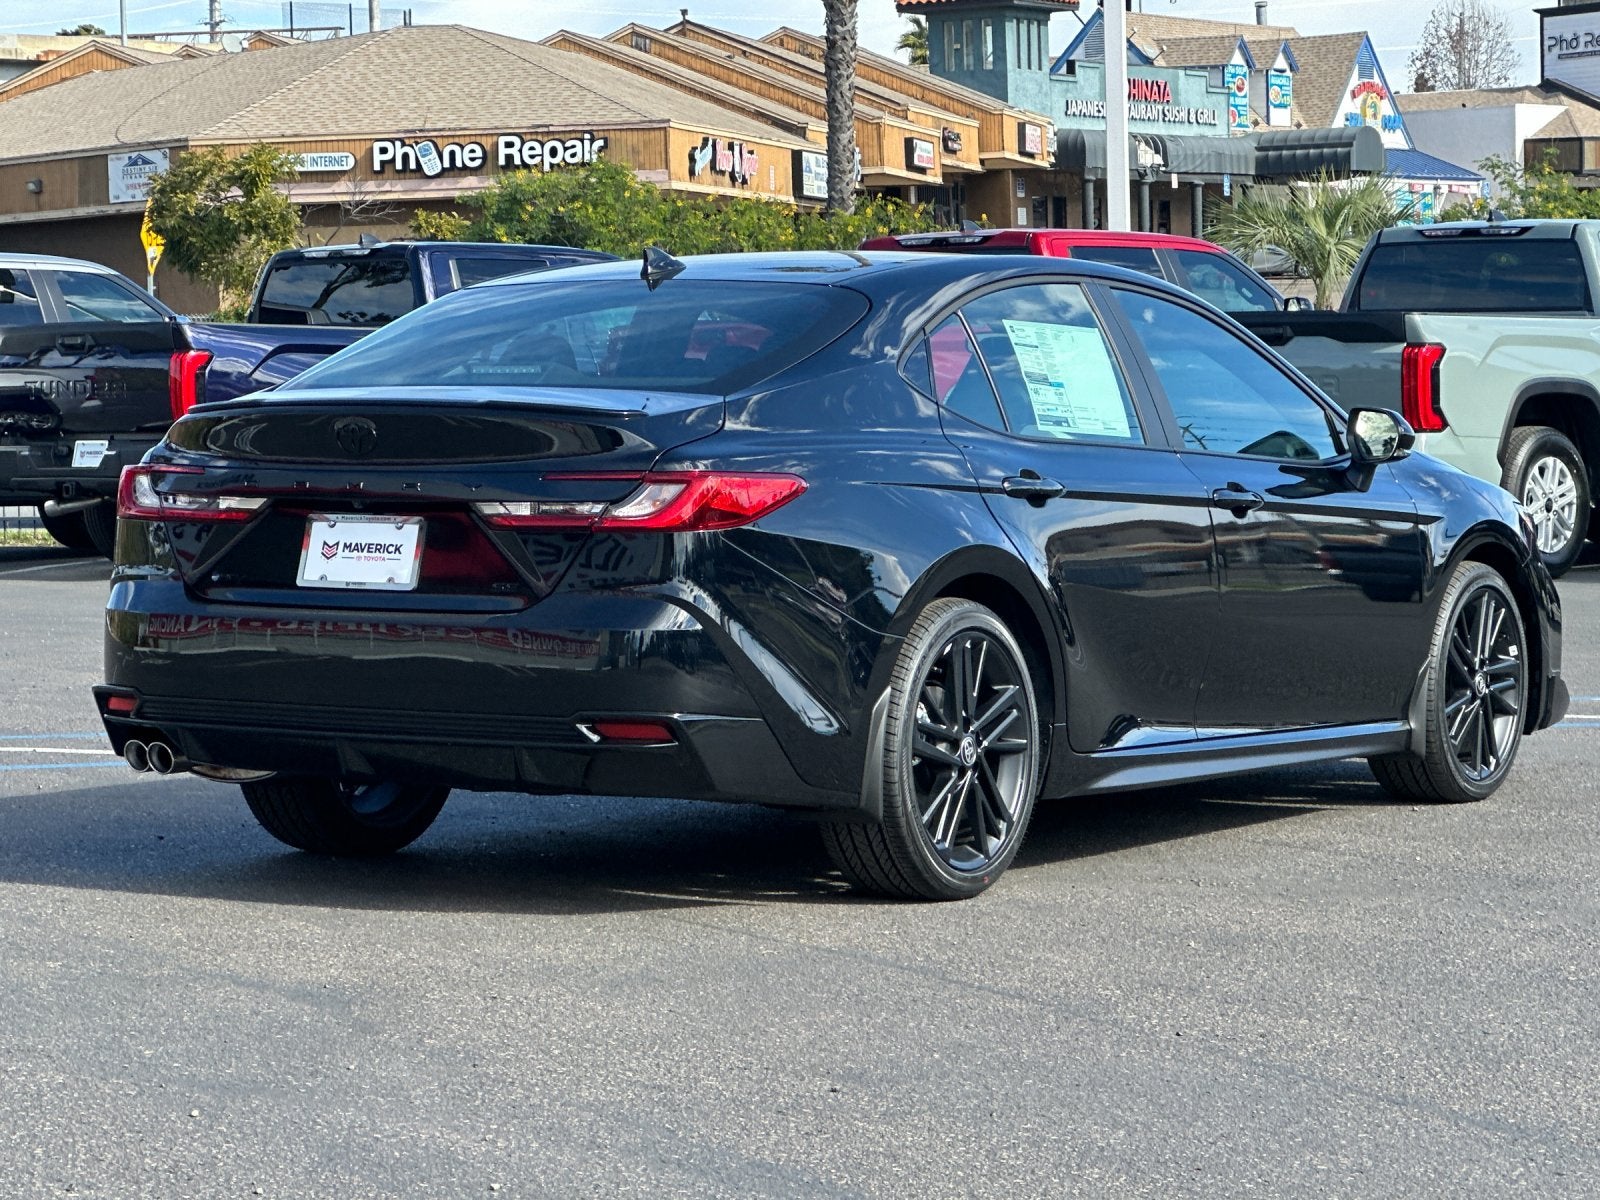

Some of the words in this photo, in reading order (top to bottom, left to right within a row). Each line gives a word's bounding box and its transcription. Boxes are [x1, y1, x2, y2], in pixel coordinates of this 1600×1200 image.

[1128, 78, 1172, 103] HINATA
[1163, 105, 1187, 122] SUSHI
[1189, 107, 1195, 121] &
[1197, 108, 1218, 124] GRILL
[309, 155, 350, 168] INTERNET
[498, 133, 606, 172] Repair
[24, 380, 127, 400] TUND
[342, 542, 404, 555] MAVERICK
